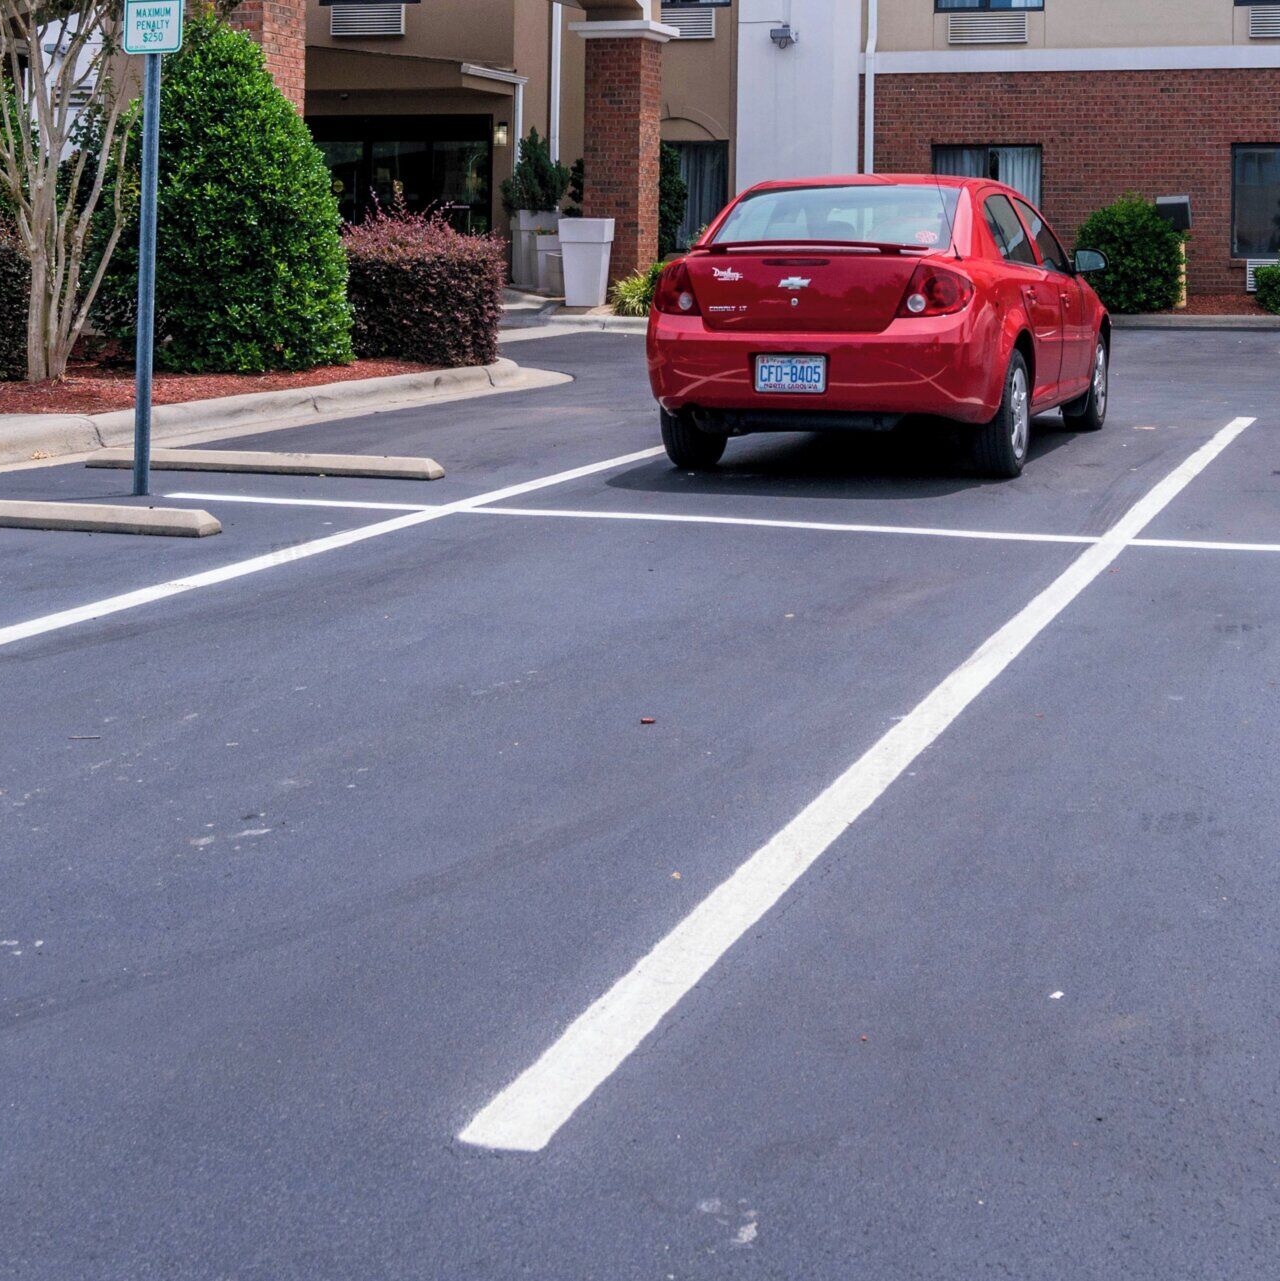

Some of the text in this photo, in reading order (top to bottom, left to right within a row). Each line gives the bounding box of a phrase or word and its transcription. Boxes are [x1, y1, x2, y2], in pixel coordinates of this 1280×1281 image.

[136, 7, 172, 18] MAXIMUM
[136, 19, 170, 30] PENALTY
[142, 32, 164, 43] $250
[760, 365, 821, 384] CFD-8405
